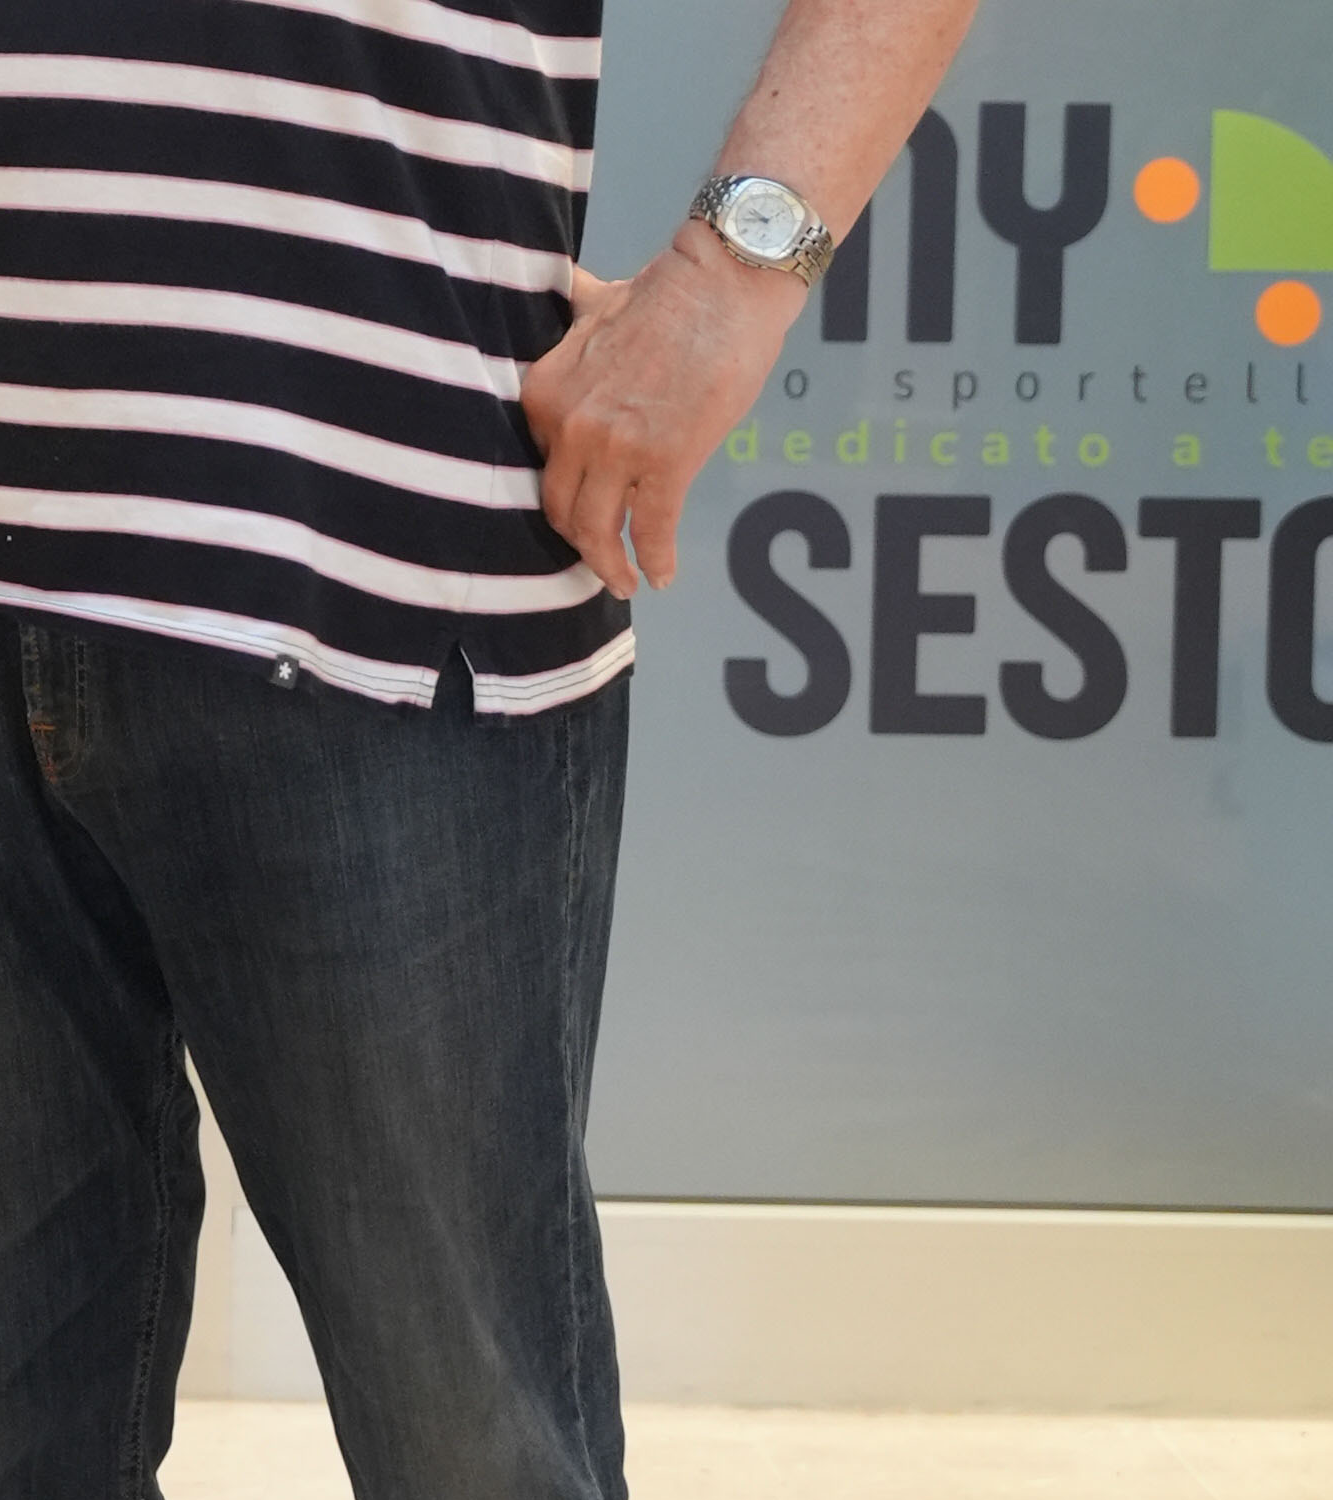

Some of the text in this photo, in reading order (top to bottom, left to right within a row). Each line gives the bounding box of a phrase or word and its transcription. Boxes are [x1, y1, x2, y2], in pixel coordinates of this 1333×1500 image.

[893, 361, 1310, 413] sportell
[724, 417, 1111, 468] dedicato
[1172, 432, 1202, 468] a
